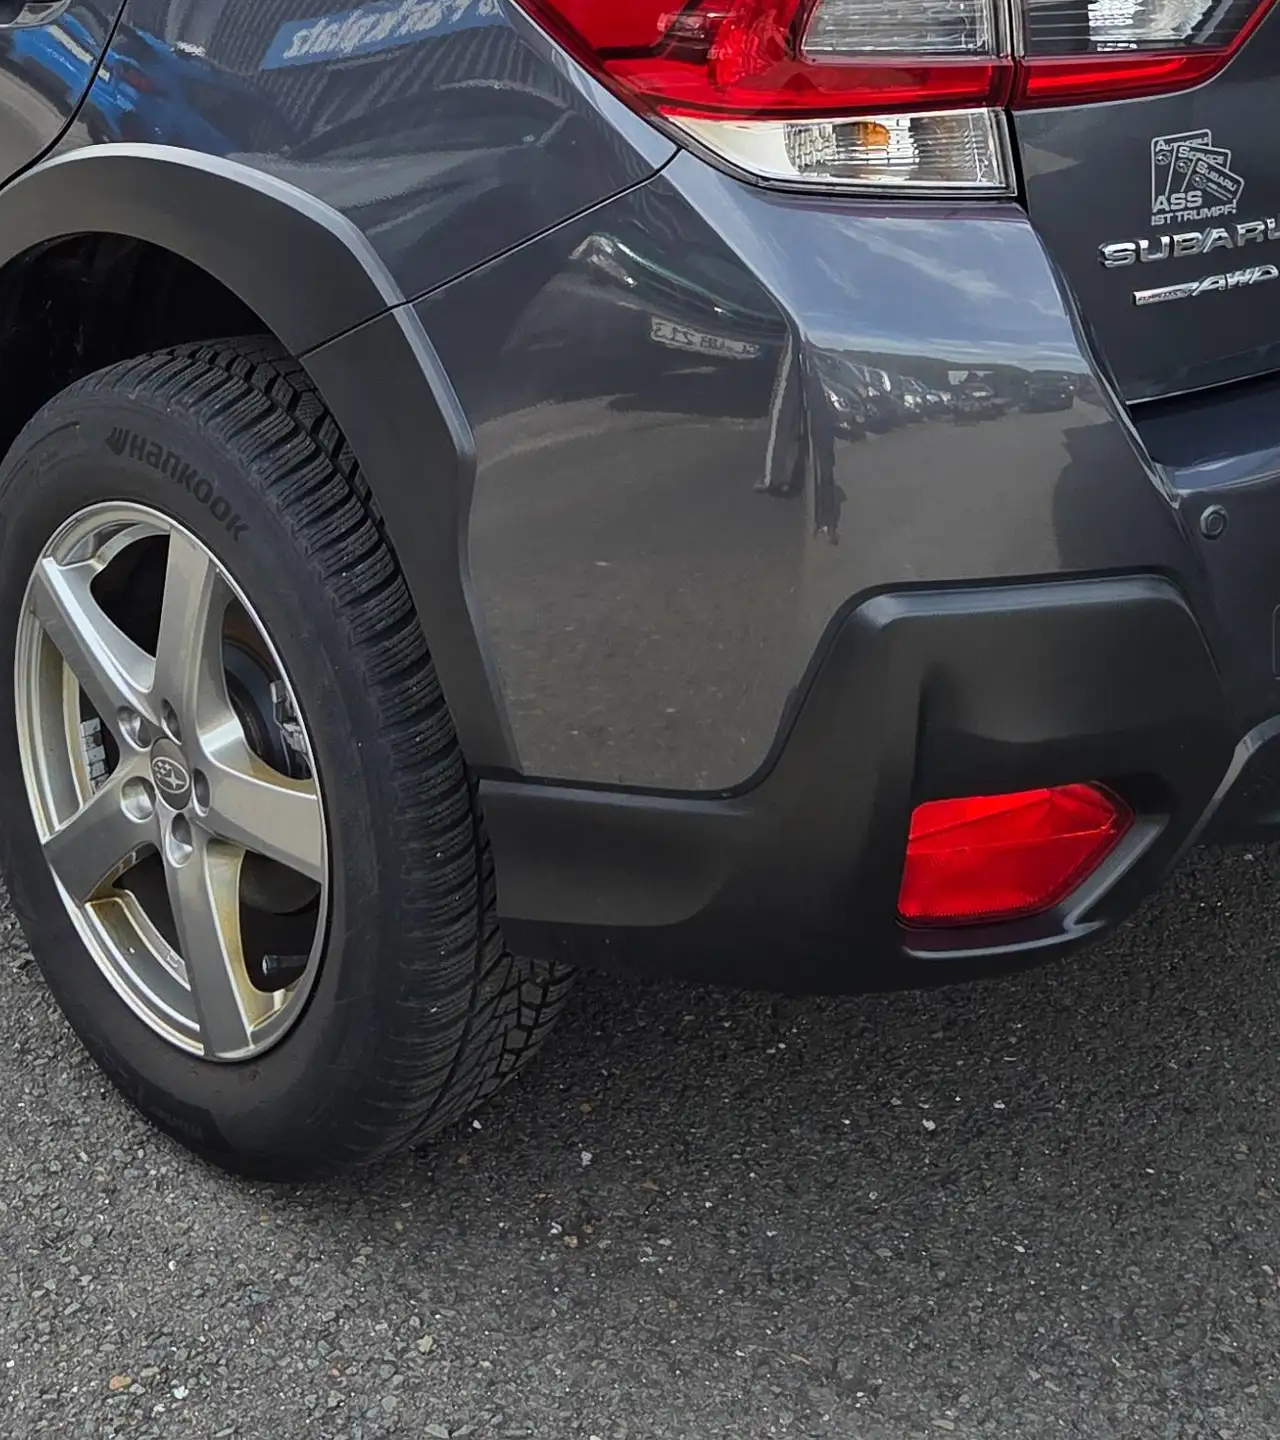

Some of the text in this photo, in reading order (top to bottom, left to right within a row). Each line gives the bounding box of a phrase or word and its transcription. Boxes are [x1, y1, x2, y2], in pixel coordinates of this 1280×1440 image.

[1152, 190, 1203, 213] ASS
[1150, 213, 1174, 227] IST
[1192, 264, 1279, 296] AWD
